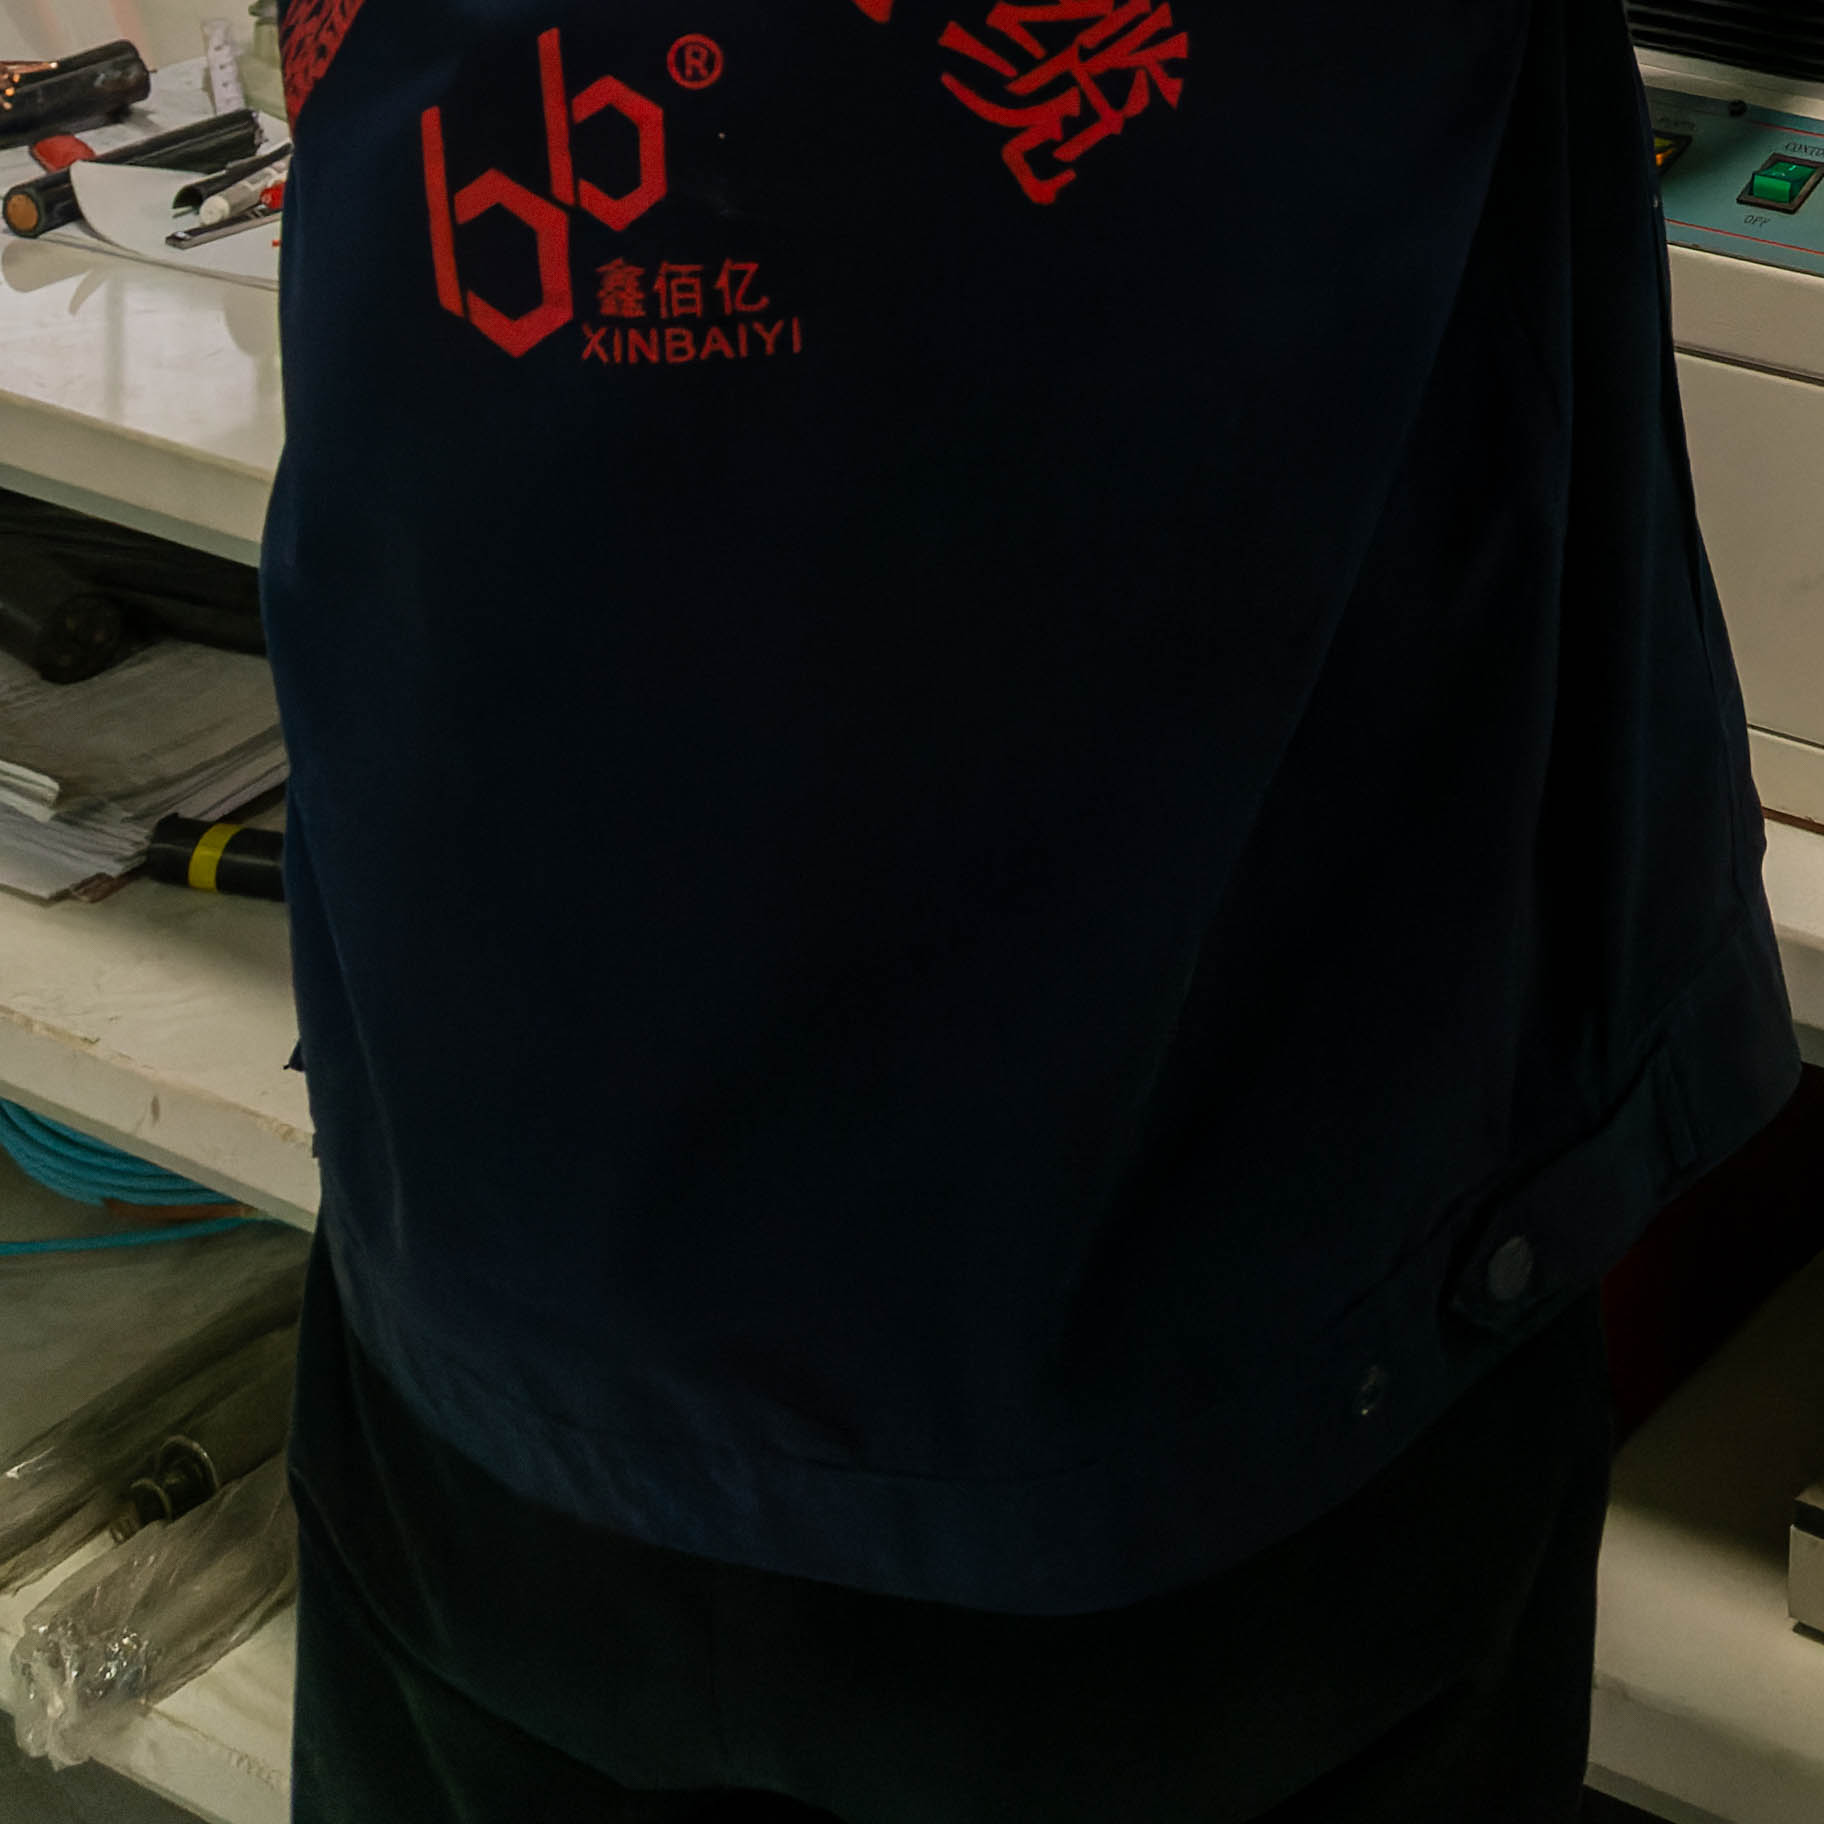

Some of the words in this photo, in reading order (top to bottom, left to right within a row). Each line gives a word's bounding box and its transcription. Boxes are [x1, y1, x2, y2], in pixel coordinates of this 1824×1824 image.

[596, 256, 771, 319] 鑫佰亿
[581, 316, 804, 366] XINBAIYI
